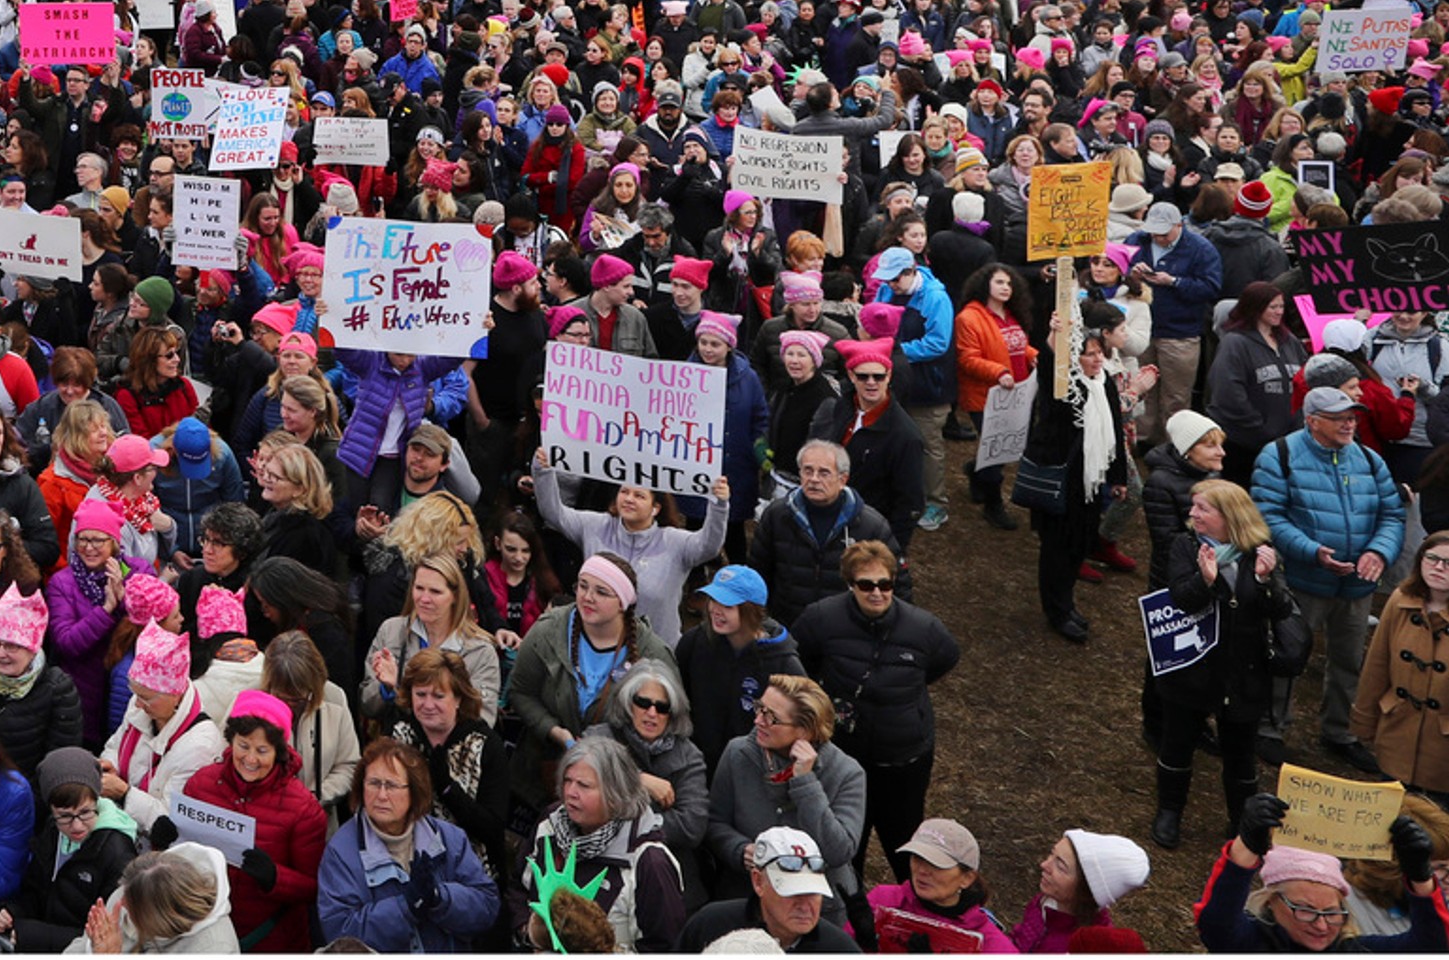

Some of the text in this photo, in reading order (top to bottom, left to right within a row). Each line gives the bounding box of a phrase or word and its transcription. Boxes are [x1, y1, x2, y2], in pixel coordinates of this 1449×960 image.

[44, 9, 89, 21] SMASH
[55, 29, 80, 40] THE
[1330, 17, 1409, 34] NI PUTAS
[22, 47, 115, 58] PATRIARCHY
[1326, 36, 1406, 53] NI SANTAS
[1328, 54, 1376, 70] SOLO
[152, 70, 205, 89] PEOPLE
[237, 88, 277, 102] LOVE
[219, 101, 255, 118] NOT
[242, 106, 285, 127] HATE
[151, 121, 206, 137] NOT PROFIT
[217, 126, 268, 140] MAKES
[216, 137, 277, 152] AMERICA
[739, 134, 828, 154] NO REGRESSION
[216, 151, 266, 165] GREAT
[788, 159, 828, 173] RIGHTS
[738, 173, 821, 192] CIVIL RIGHTS
[338, 223, 452, 265] The Future
[1298, 230, 1343, 257] MY
[18, 253, 42, 264] TREAD
[45, 256, 55, 265] ON
[57, 258, 69, 267] ME
[1310, 258, 1355, 286] MY
[342, 266, 451, 305] Is Female
[1337, 284, 1449, 313] CHOIC
[551, 342, 712, 394] GIRLS JUST
[547, 370, 698, 419] WANNA HAVE
[540, 399, 724, 465] FUNDAMENTAL
[549, 444, 712, 496] RIGHTS
[1290, 775, 1383, 805] SHOW WHAT
[177, 803, 246, 833] RESPECT
[1286, 795, 1384, 827] WE ARE FOR
